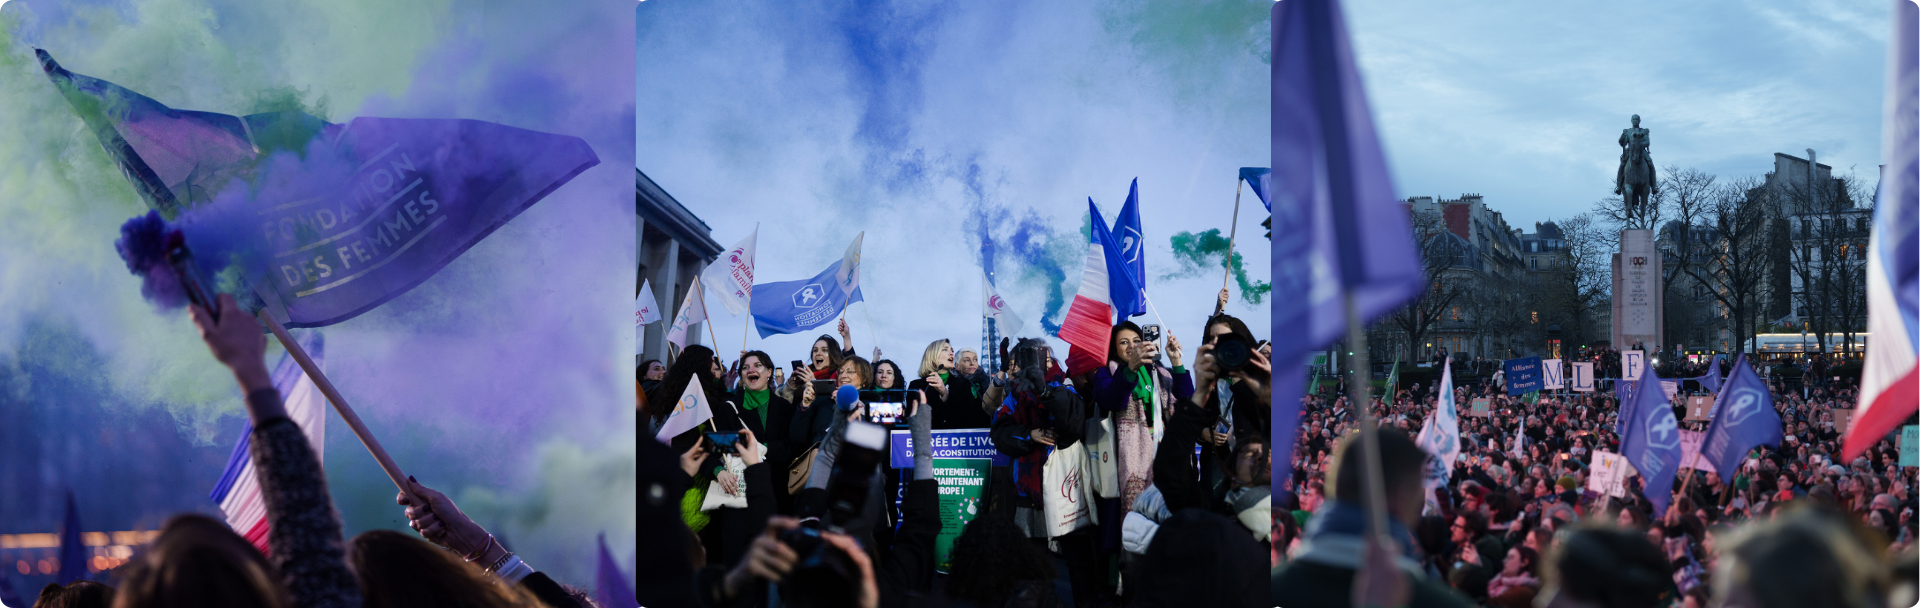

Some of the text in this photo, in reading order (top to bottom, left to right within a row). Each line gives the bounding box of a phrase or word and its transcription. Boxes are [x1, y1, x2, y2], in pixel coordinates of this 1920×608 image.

[262, 152, 417, 247] FONDATION
[281, 190, 438, 287] DES FEMMES
[1629, 256, 1648, 266] FOCH
[1544, 361, 1564, 387] M
[1574, 365, 1592, 388] L
[1626, 354, 1640, 378] F
[1473, 401, 1489, 412] IVG
[940, 448, 997, 456] CONSTITUTION
[951, 437, 966, 447] DE
